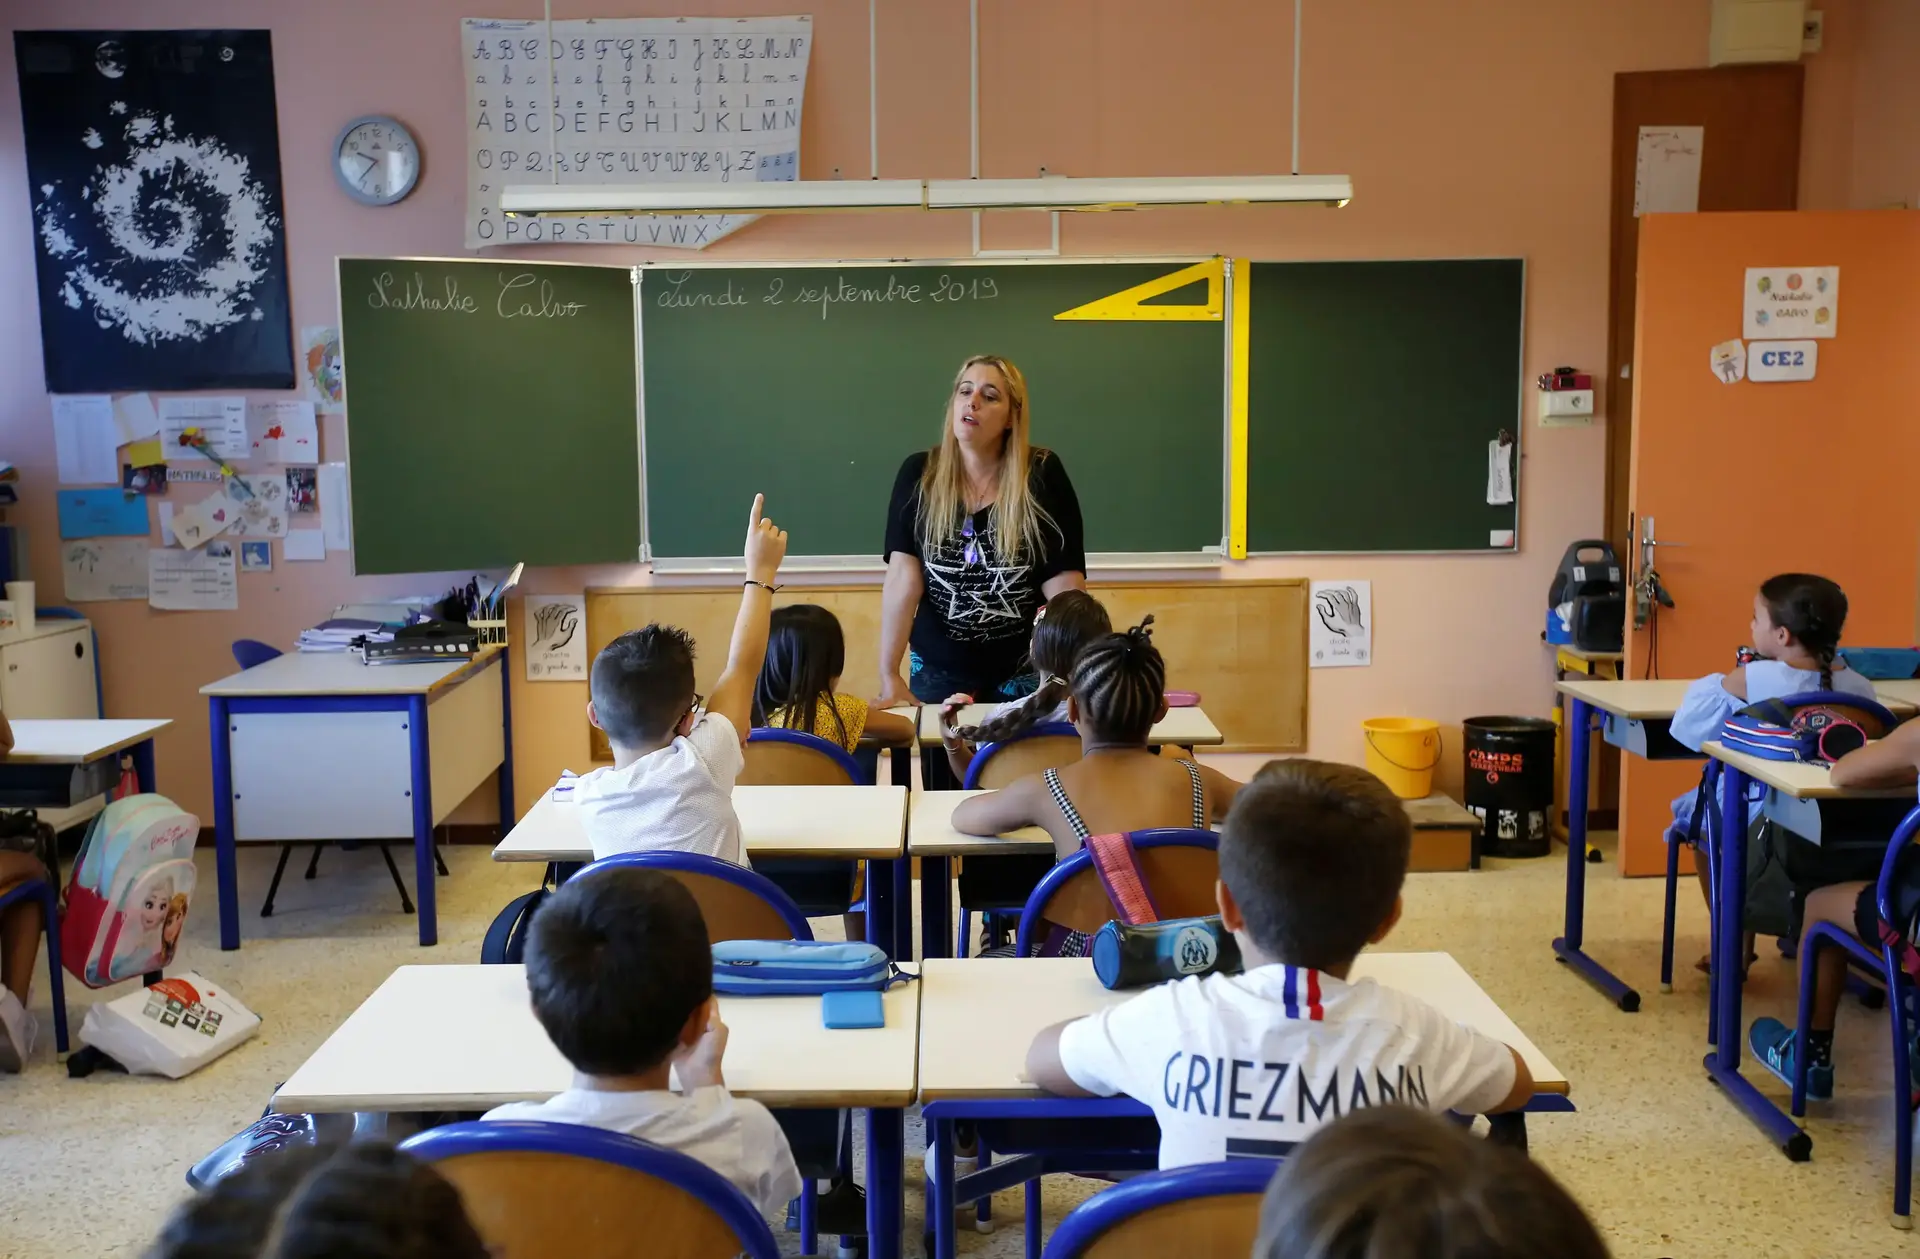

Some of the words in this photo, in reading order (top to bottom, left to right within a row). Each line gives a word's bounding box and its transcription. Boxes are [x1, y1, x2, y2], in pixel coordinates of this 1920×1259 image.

[472, 39, 491, 60] A
[496, 40, 515, 60] B
[519, 39, 539, 60] C
[476, 75, 487, 84] a
[502, 64, 512, 84] b
[595, 64, 603, 95] f
[506, 95, 513, 108] b
[627, 100, 634, 115] g
[647, 95, 655, 108] h
[719, 95, 727, 108] k
[476, 110, 492, 131] A
[504, 113, 517, 132] B
[525, 113, 540, 132] C
[575, 113, 587, 132] E
[599, 113, 610, 132] F
[618, 113, 633, 132] G
[645, 113, 658, 132] H
[693, 113, 705, 132] J
[716, 113, 730, 132] K
[741, 113, 751, 131] L
[762, 112, 775, 130] M
[785, 109, 796, 128] N
[500, 151, 519, 170] P
[738, 151, 755, 171] Z
[478, 219, 493, 239] O
[506, 222, 519, 240] P
[552, 223, 565, 240] R
[576, 223, 589, 240] S
[599, 222, 614, 240] T
[625, 224, 637, 242] U
[648, 225, 661, 242] V
[669, 224, 687, 243] W
[694, 224, 708, 243] X
[368, 270, 479, 313] Nathalie
[497, 272, 587, 318] Calvo
[657, 270, 748, 308] Lundi
[763, 277, 785, 306] 2
[793, 275, 922, 320] septembre
[929, 274, 999, 303] 2019
[1761, 350, 1804, 366] CE2
[1164, 1050, 1429, 1124] GRIEZMANN
